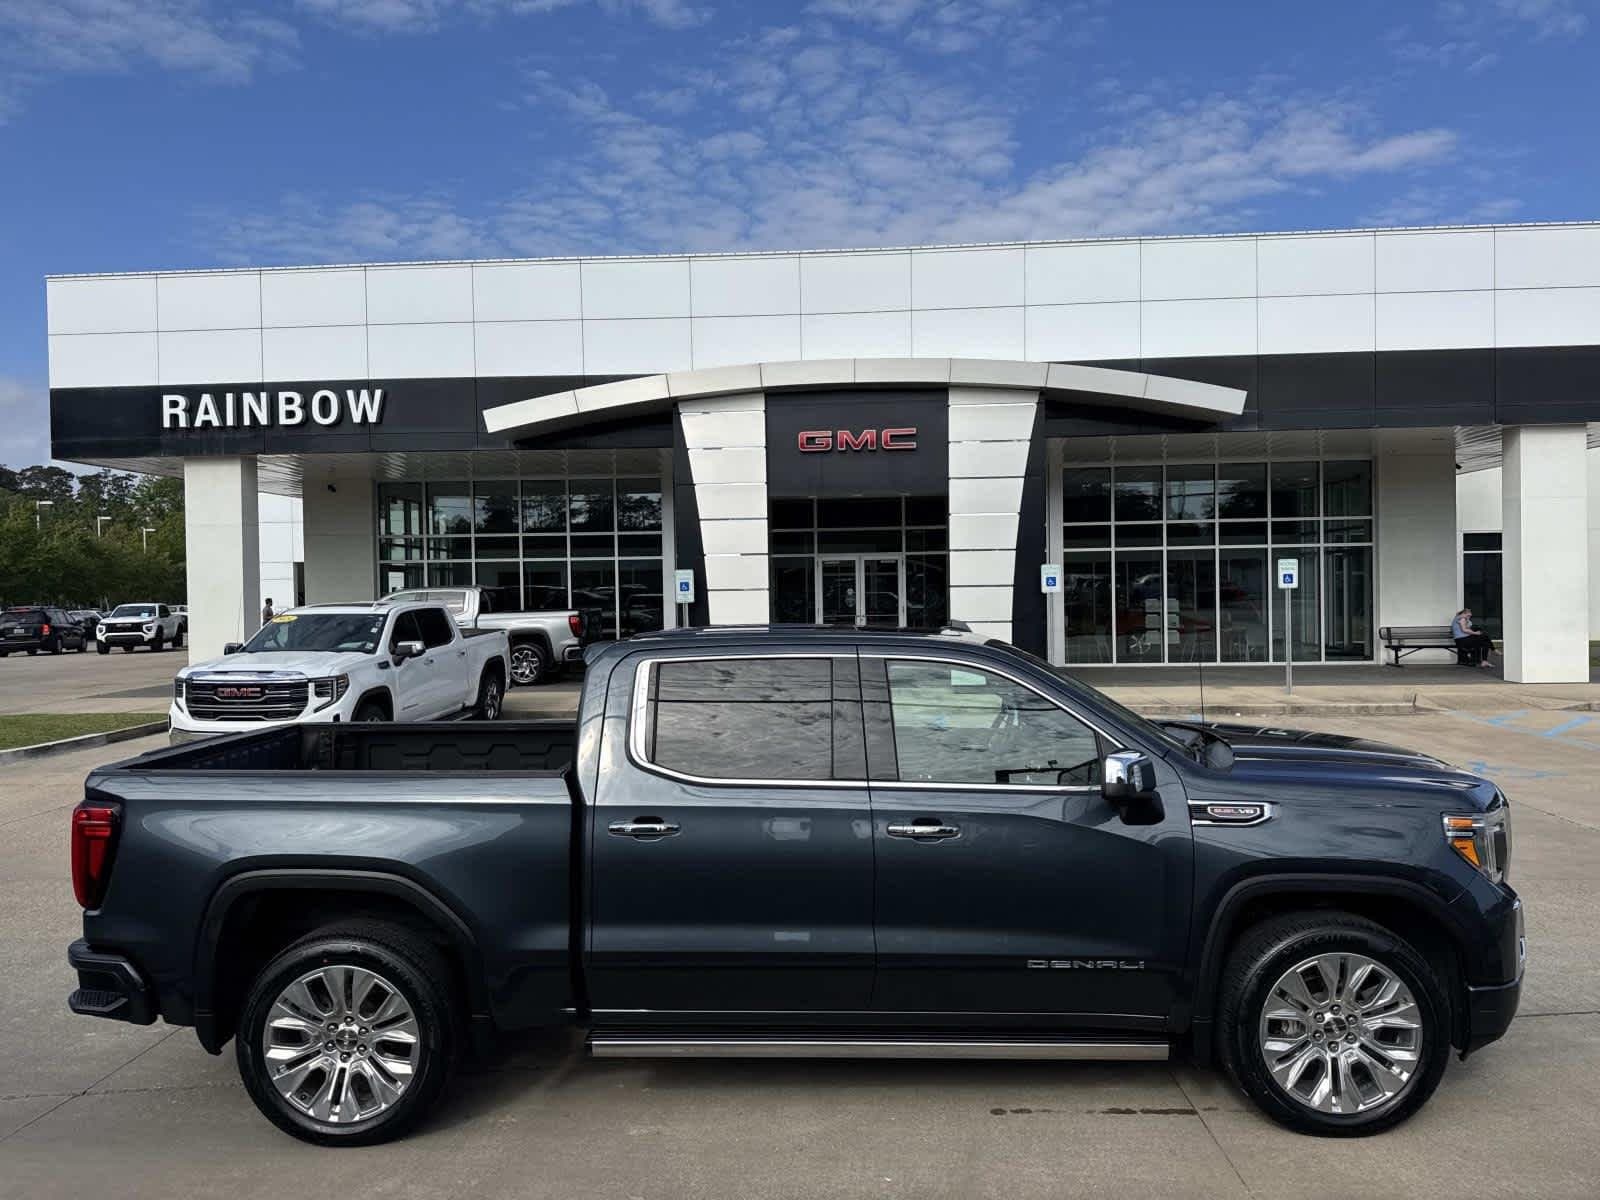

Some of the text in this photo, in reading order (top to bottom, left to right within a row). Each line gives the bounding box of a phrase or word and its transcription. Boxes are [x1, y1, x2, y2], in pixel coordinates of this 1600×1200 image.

[162, 389, 383, 428] RAINBOW
[798, 427, 917, 452] GMC
[216, 687, 262, 697] GMC
[1027, 959, 1145, 969] DENALI
